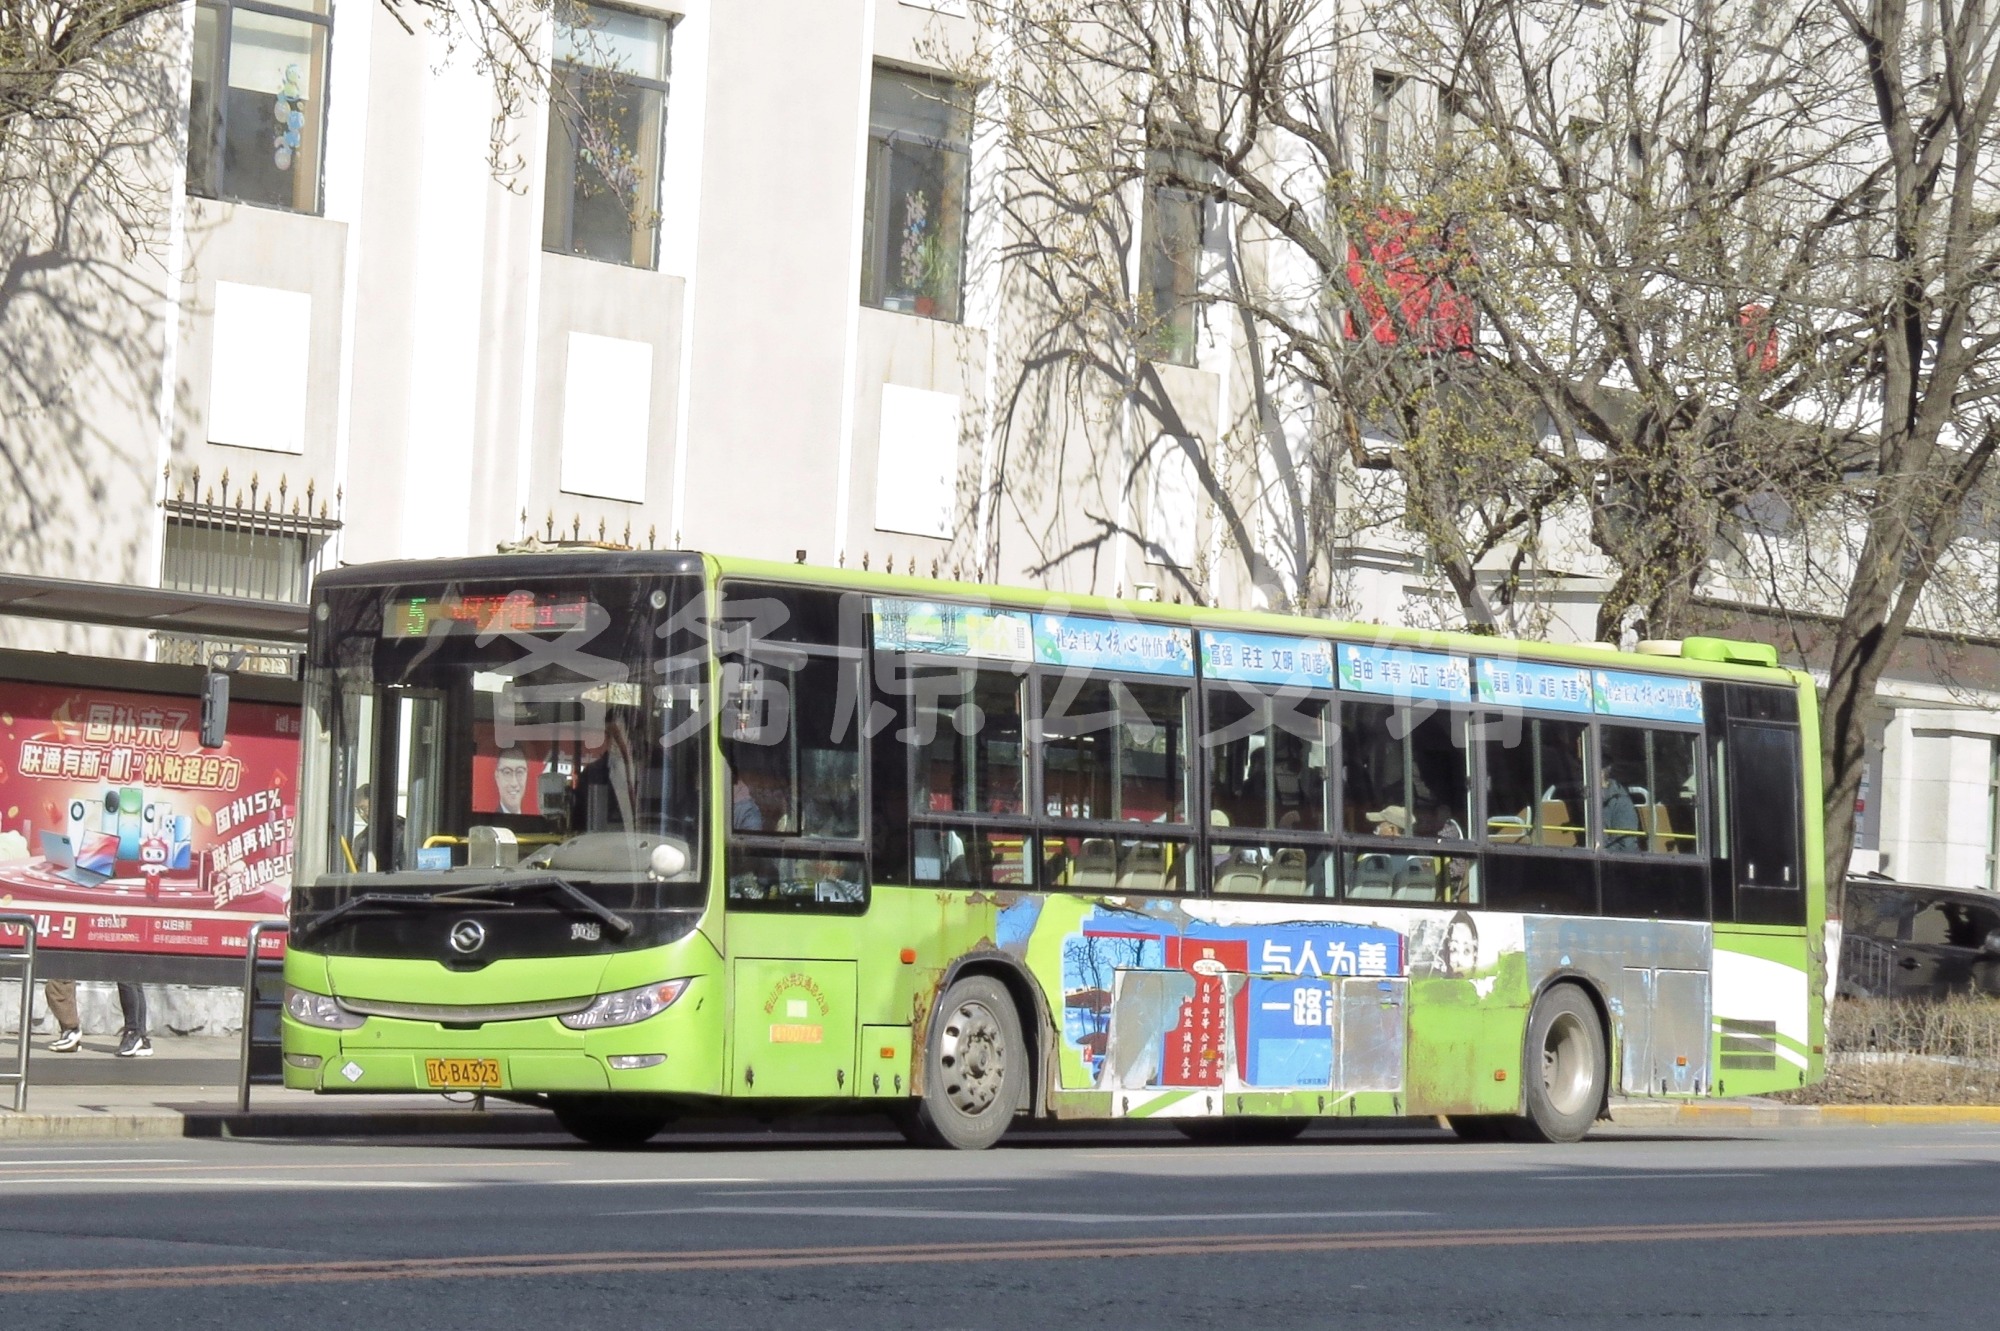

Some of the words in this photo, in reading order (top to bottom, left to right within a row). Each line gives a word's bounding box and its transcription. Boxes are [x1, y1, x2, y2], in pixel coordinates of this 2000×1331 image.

[407, 598, 427, 635] 5
[1055, 629, 1177, 659] 社会主义核心价值观
[1210, 644, 1233, 666] 富强
[1241, 646, 1264, 669] 民主
[1272, 650, 1294, 671] 文明
[1301, 652, 1323, 674] 和谐
[1353, 658, 1373, 679] 自由
[1381, 661, 1402, 683] 平等
[1409, 665, 1430, 686] 公正
[1436, 667, 1457, 688] 法治
[1561, 679, 1578, 700] 友善
[86, 704, 188, 748] 国补来了
[215, 788, 281, 835] 国补15%
[1261, 939, 1387, 977] 与人为善
